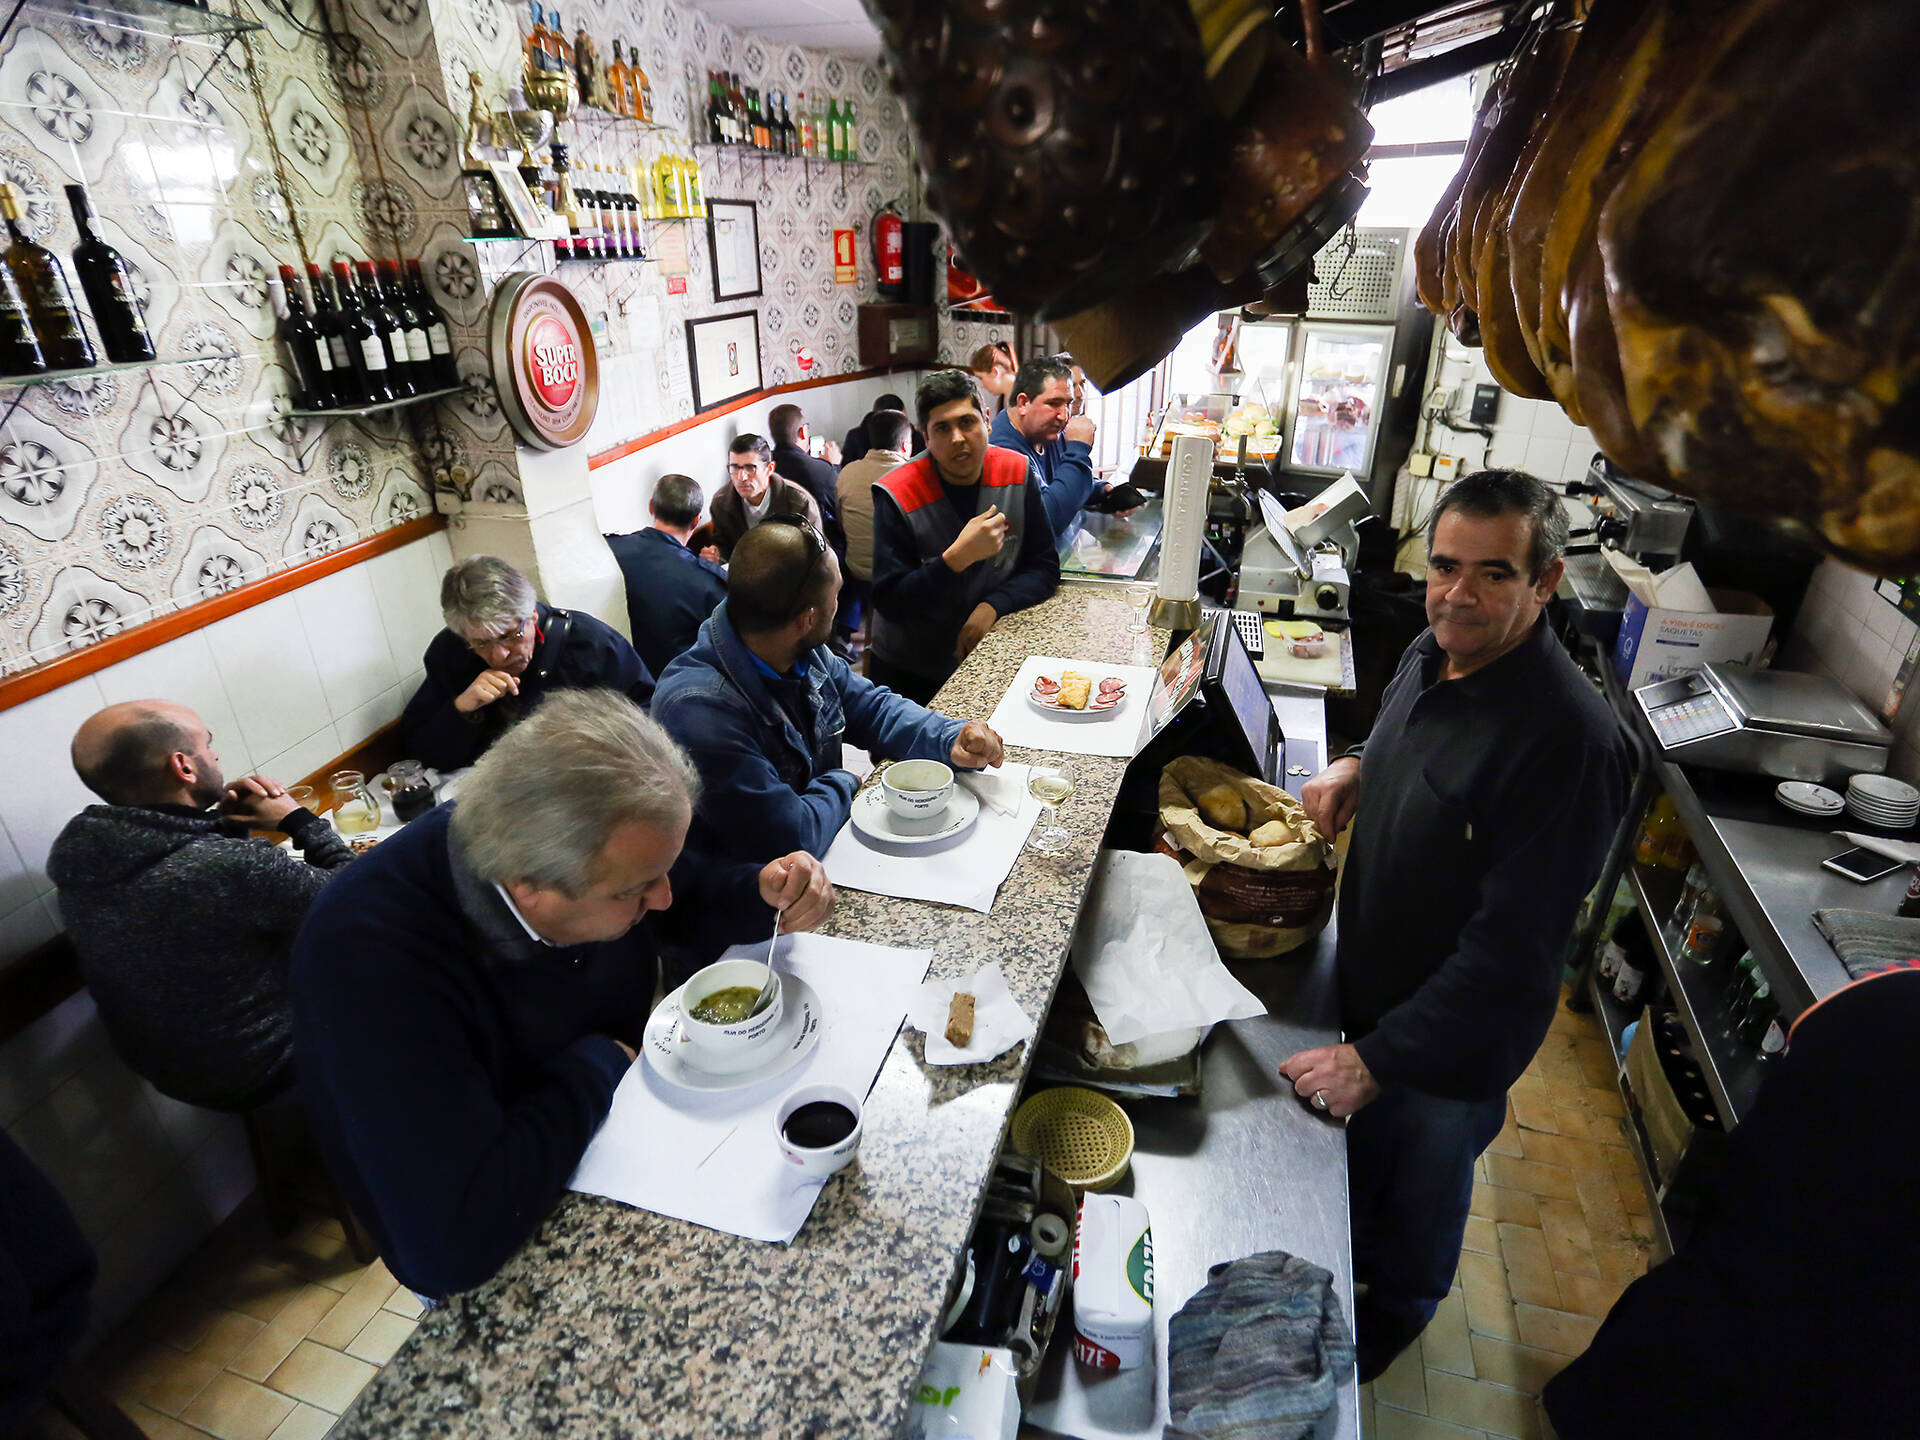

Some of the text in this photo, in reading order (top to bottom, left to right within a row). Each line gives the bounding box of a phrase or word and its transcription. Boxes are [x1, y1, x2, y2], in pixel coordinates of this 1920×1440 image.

[534, 343, 577, 367] SUPER
[541, 362, 578, 386] BOCK
[747, 1028, 766, 1040] PORTO
[1074, 1336, 1108, 1368] RIZE
